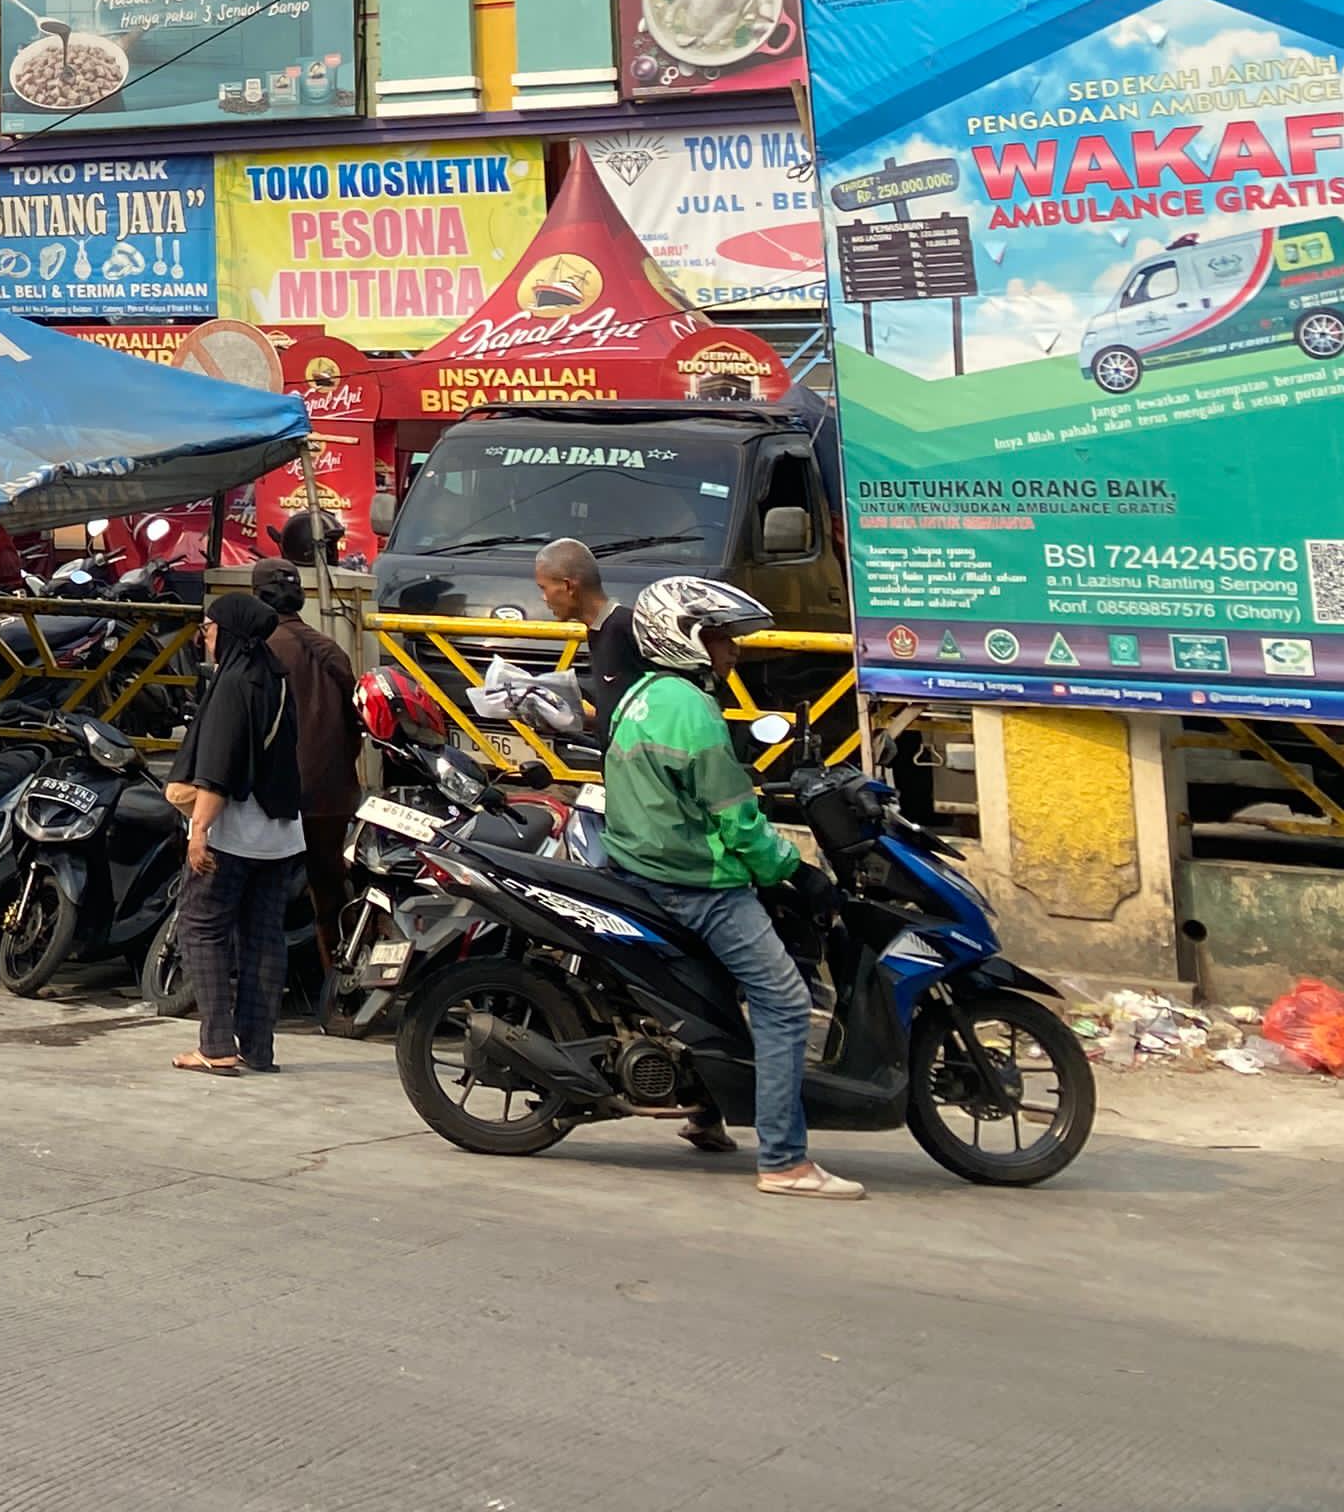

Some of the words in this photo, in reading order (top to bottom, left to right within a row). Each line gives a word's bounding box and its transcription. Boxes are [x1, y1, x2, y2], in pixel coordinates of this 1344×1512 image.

[120, 12, 159, 30] Hanya
[269, 0, 310, 18] Bango
[1069, 70, 1200, 102] SEDEKAH
[1208, 55, 1338, 88] JARIYAH
[966, 101, 1140, 136] PENGADAAN
[1149, 78, 1343, 118] AMBULANCE
[683, 134, 753, 172] TOKO
[971, 112, 1344, 201] WAKAF
[9, 165, 76, 186] TOKO
[84, 159, 169, 183] PERAK
[246, 165, 330, 201] TOKO
[338, 156, 512, 199] KOSMETIK
[676, 195, 745, 214] JUAL
[988, 188, 1205, 230] AMBULANCE
[1215, 177, 1344, 213] GRATIS
[289, 205, 470, 261] PESONA
[15, 285, 46, 298] BELI
[51, 285, 62, 298] &
[67, 283, 126, 298] TERIMA
[130, 282, 208, 297] PESANAN
[278, 266, 487, 319] MUTIARA
[697, 286, 825, 303] SERPONG
[451, 310, 563, 360] Kapal
[566, 306, 648, 347] Api
[677, 360, 705, 374] 100
[706, 361, 773, 375] UMROH
[700, 351, 750, 361] GEBYAR
[438, 367, 596, 387] INSYAALLAH
[332, 384, 363, 410] Api
[421, 390, 487, 412] BISA
[1091, 403, 1132, 421] Jangan
[1273, 368, 1326, 387] beramal
[1059, 423, 1098, 441] pahala
[1103, 418, 1132, 432] akan
[279, 497, 302, 508] 100
[860, 480, 1003, 498] DIBUTUHKAN
[1012, 480, 1097, 498] ORANG
[1107, 479, 1176, 500] BAIK,
[861, 502, 905, 513] UNTUK
[911, 502, 1011, 513] MEWUJUDKAN
[1016, 502, 1111, 513] AMBULANCE
[1118, 502, 1177, 514] GRATIS
[1044, 544, 1096, 568] BSI
[1104, 545, 1299, 572] 7244245678
[1046, 574, 1073, 587] a.n
[1077, 574, 1142, 589] Lazisnu
[1147, 575, 1216, 594] Ranting
[1220, 576, 1299, 596] Serpong
[1048, 599, 1092, 614] Konf.
